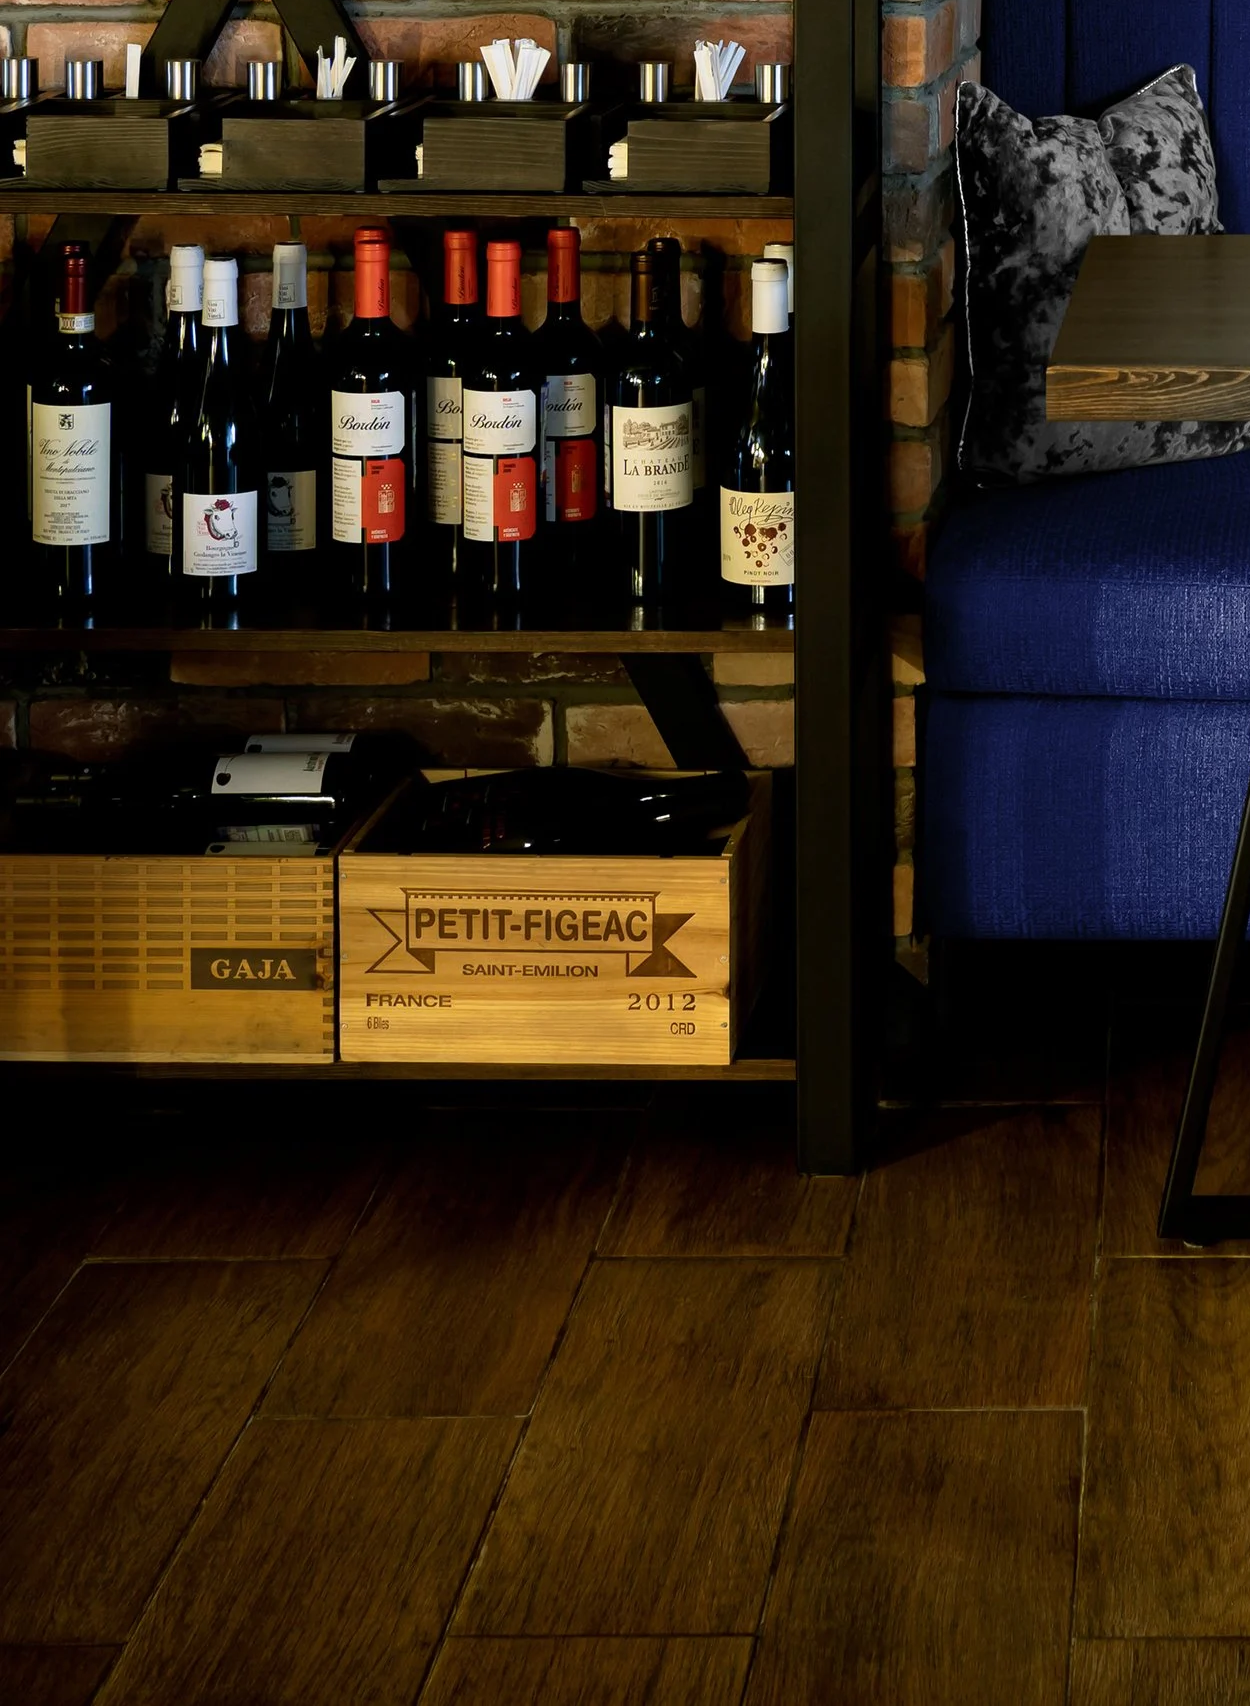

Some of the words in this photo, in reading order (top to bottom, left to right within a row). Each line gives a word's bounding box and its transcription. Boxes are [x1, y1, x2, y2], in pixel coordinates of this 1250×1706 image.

[435, 399, 463, 414] Bo
[546, 397, 582, 412] ordón
[338, 414, 391, 431] Bordón
[470, 414, 522, 429] Bordón
[623, 459, 640, 476] LA
[644, 454, 691, 476] BRANDE
[414, 907, 648, 942] PETIT-FIGEAC
[210, 958, 296, 980] GAJA
[462, 963, 599, 978] SAINT-EMILION
[366, 993, 451, 1008] FRANCE
[628, 993, 696, 1011] 2012
[367, 1016, 373, 1030] 6
[670, 1022, 696, 1035] CRD
